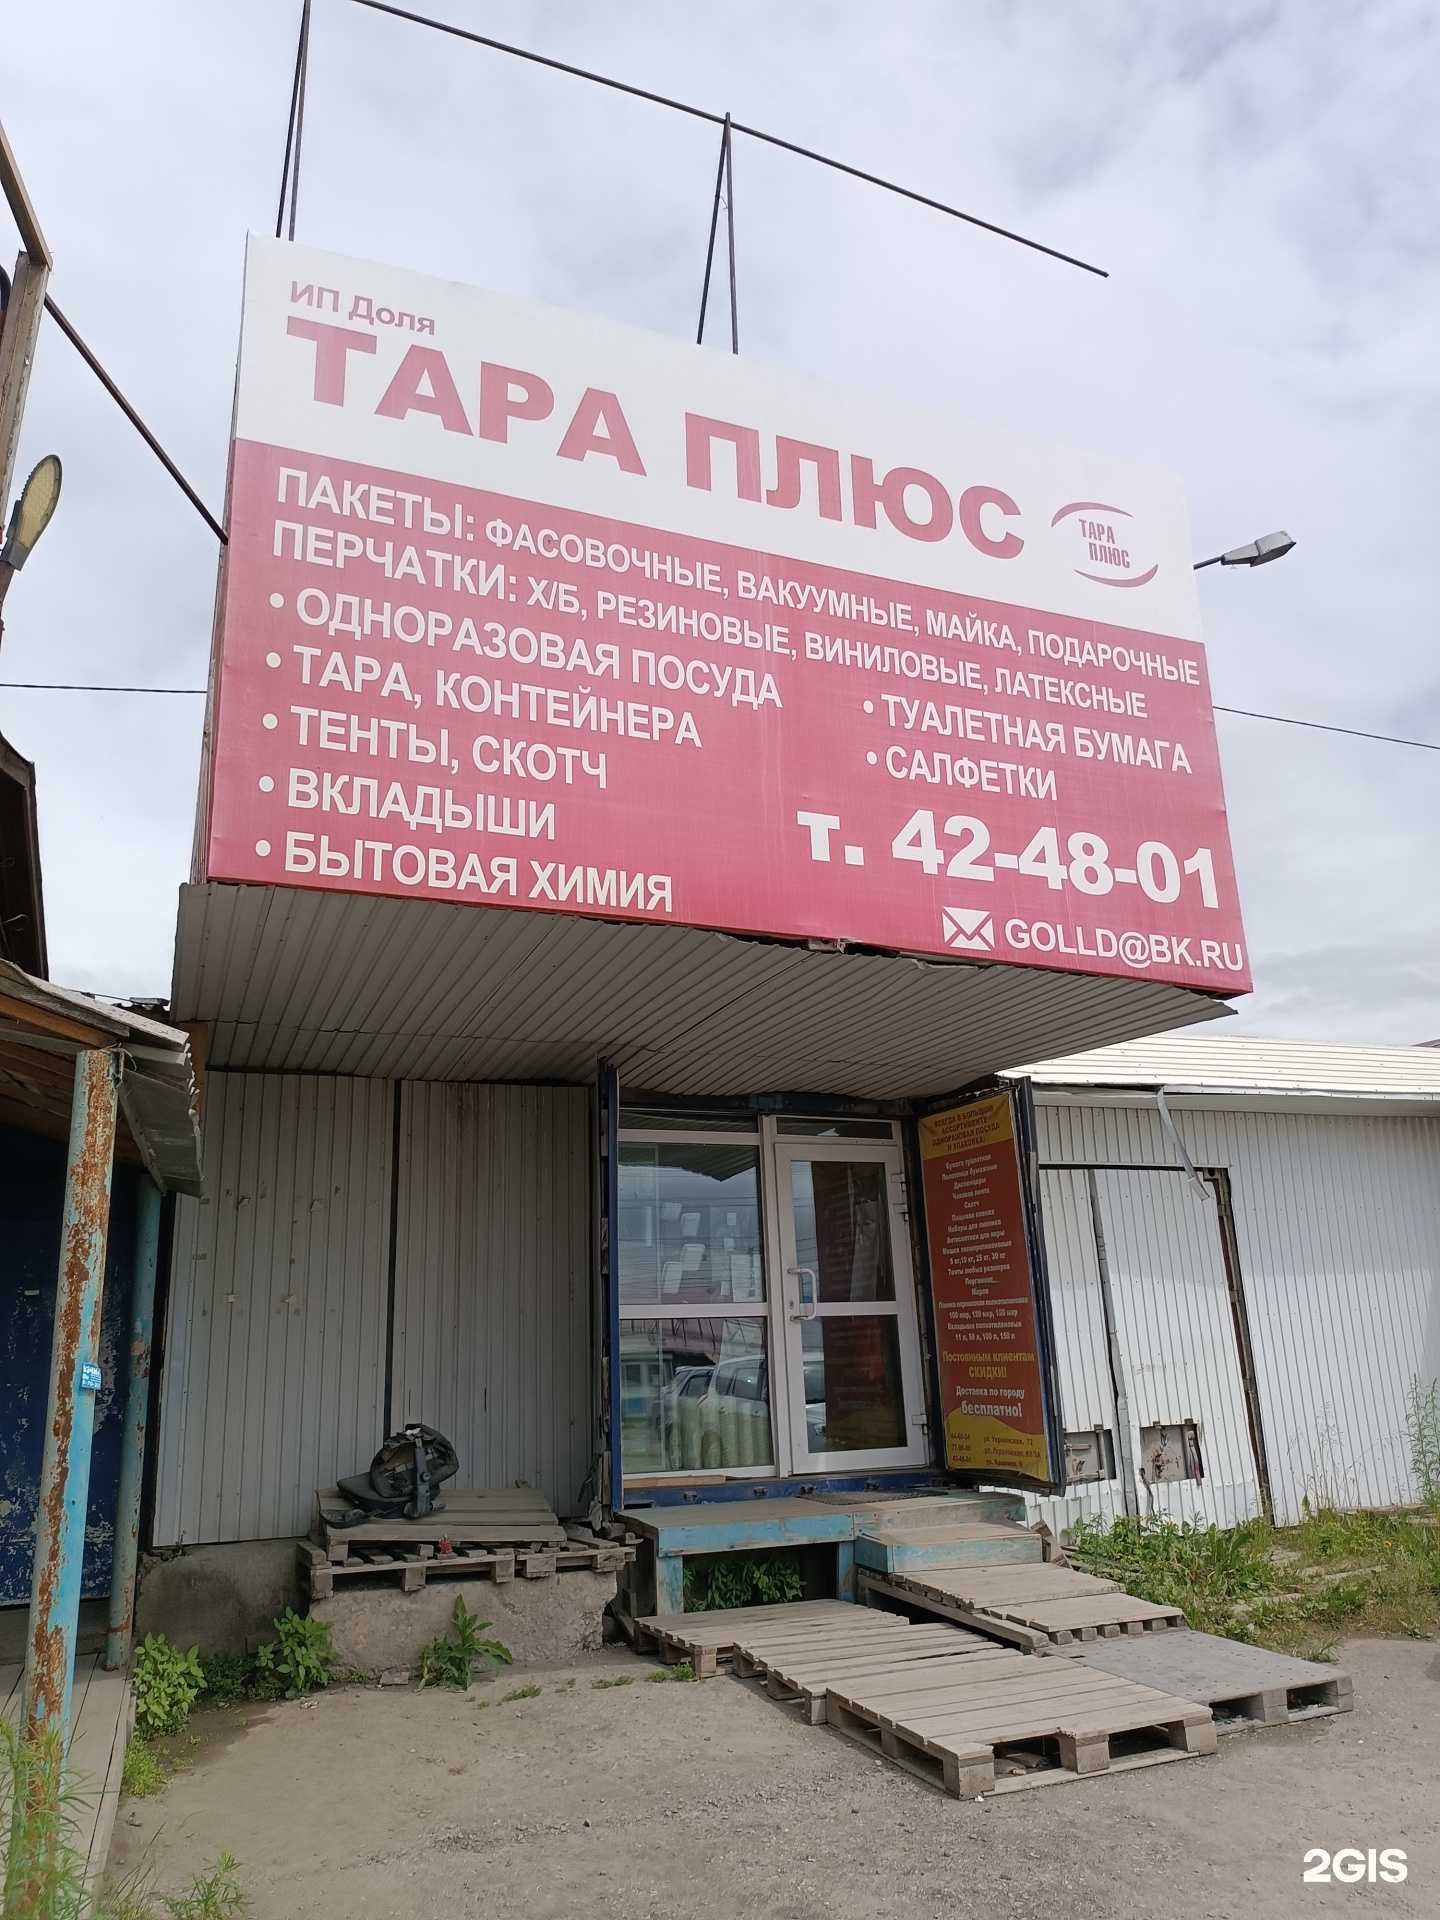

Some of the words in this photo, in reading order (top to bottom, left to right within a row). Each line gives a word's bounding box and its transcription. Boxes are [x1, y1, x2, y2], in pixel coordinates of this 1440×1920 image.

[290, 280, 340, 312] ИП
[348, 295, 436, 335] Доля
[286, 315, 647, 477] ТАРА
[684, 411, 1025, 560] ПЛЮС
[1078, 517, 1115, 545] ТАРА
[1088, 538, 1131, 569] ПЛЮС
[277, 466, 475, 542] ПАКЕТЫ:
[485, 518, 729, 599] ФАСОВОЧНЫЕ,
[738, 570, 920, 637] ВАКУУМНЫЕ,
[926, 609, 1024, 657] МАЙКА,
[1028, 630, 1200, 686] ПОДАРОЧНЫЕ
[272, 519, 517, 601] ПЕРЧАТКИ:
[526, 576, 588, 622] Х/Б,
[596, 590, 798, 661] РЕЗИНОВЫЕ,
[805, 633, 989, 696] ВИНИЛОВЫЕ,
[995, 668, 1148, 720] ЛАТЕКСНЫЕ
[296, 587, 619, 680] ОДНОРАЗОВАЯ
[631, 648, 783, 711] ПОСУДА
[292, 644, 422, 708] ТАРА,
[436, 669, 703, 748] КОНТЕЙНЕРА
[880, 693, 1066, 755] ТУАЛЕТНАЯ
[1074, 722, 1193, 775] БУМАГА
[290, 705, 460, 776] ТЕНТЫ,
[472, 734, 608, 789] СКОТЧ
[885, 745, 1058, 801] САЛФЕТКИ
[287, 767, 556, 841] ВКЛАДЫШИ
[284, 830, 518, 897] БЫТОВАЯ
[528, 861, 673, 913] ХИМИЯ
[891, 808, 1220, 910] 42-48-01
[1004, 917, 1244, 972] GOLLD@BK.RU
[989, 1388, 998, 1396] по
[1000, 1388, 1025, 1399] городу
